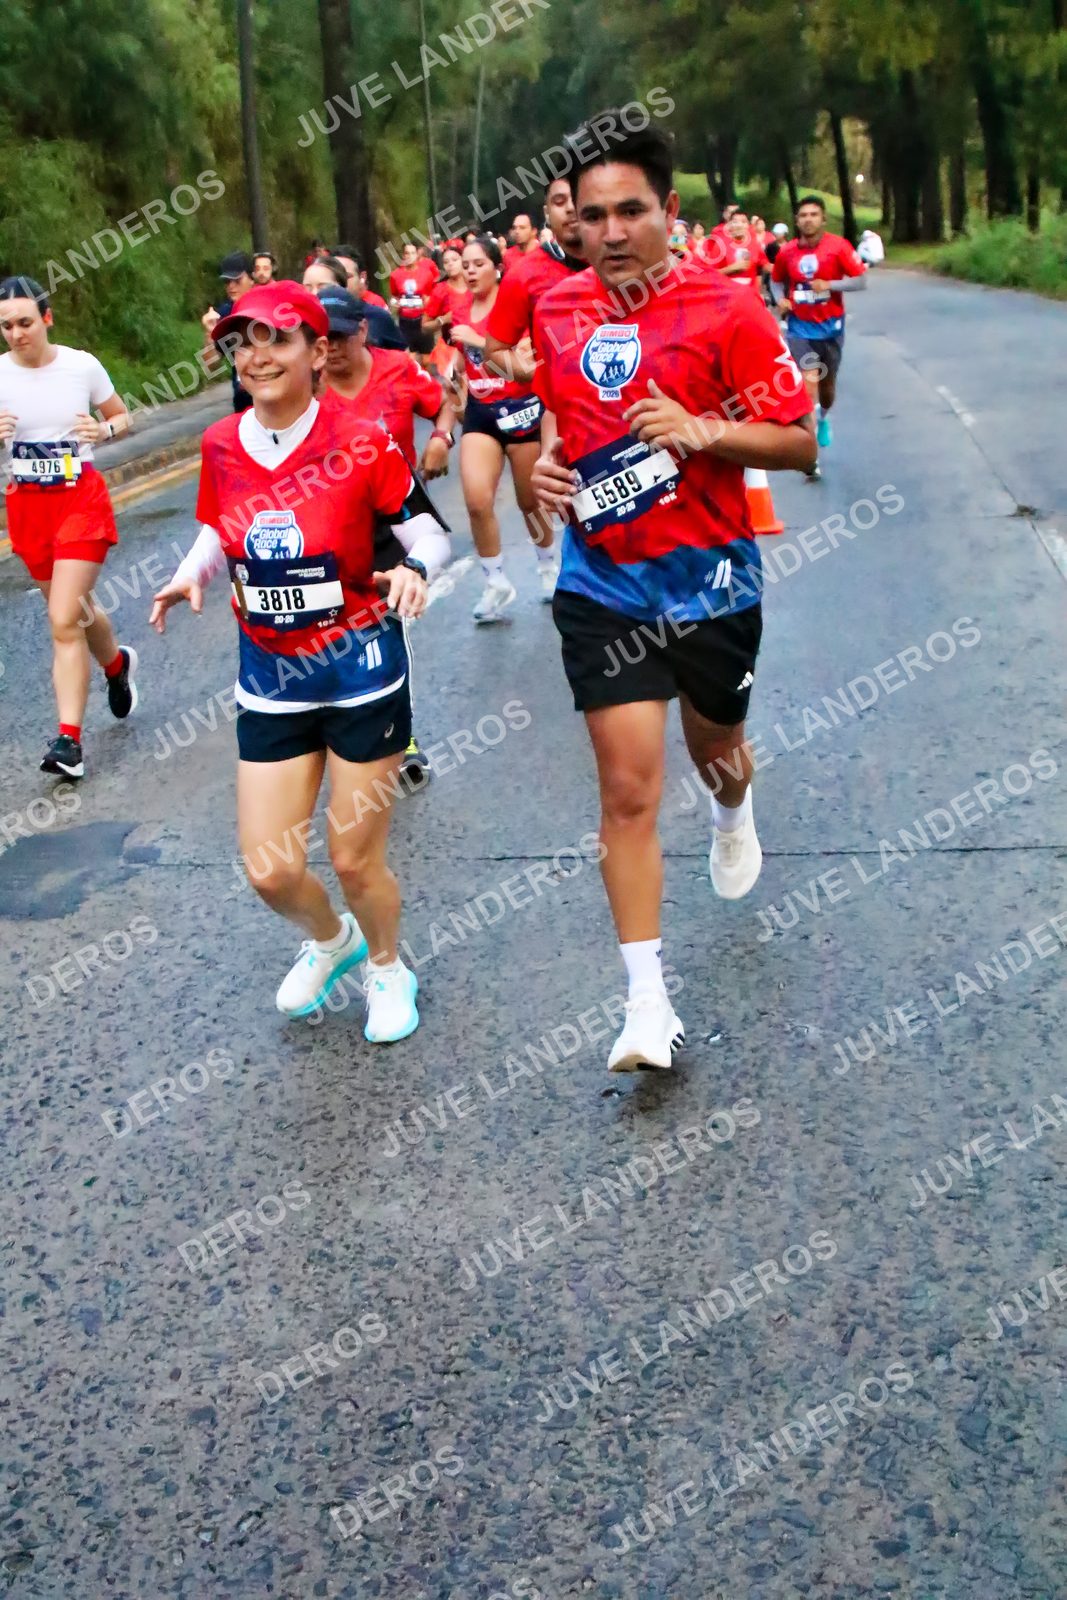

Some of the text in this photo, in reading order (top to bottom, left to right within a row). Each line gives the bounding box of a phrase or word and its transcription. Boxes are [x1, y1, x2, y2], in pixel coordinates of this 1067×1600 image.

[598, 341, 629, 353] Global
[589, 352, 614, 363] Race
[32, 460, 61, 474] 4976
[591, 469, 643, 510] 5589
[259, 528, 289, 539] Global
[254, 539, 278, 549] Race
[258, 588, 306, 611] 3818
